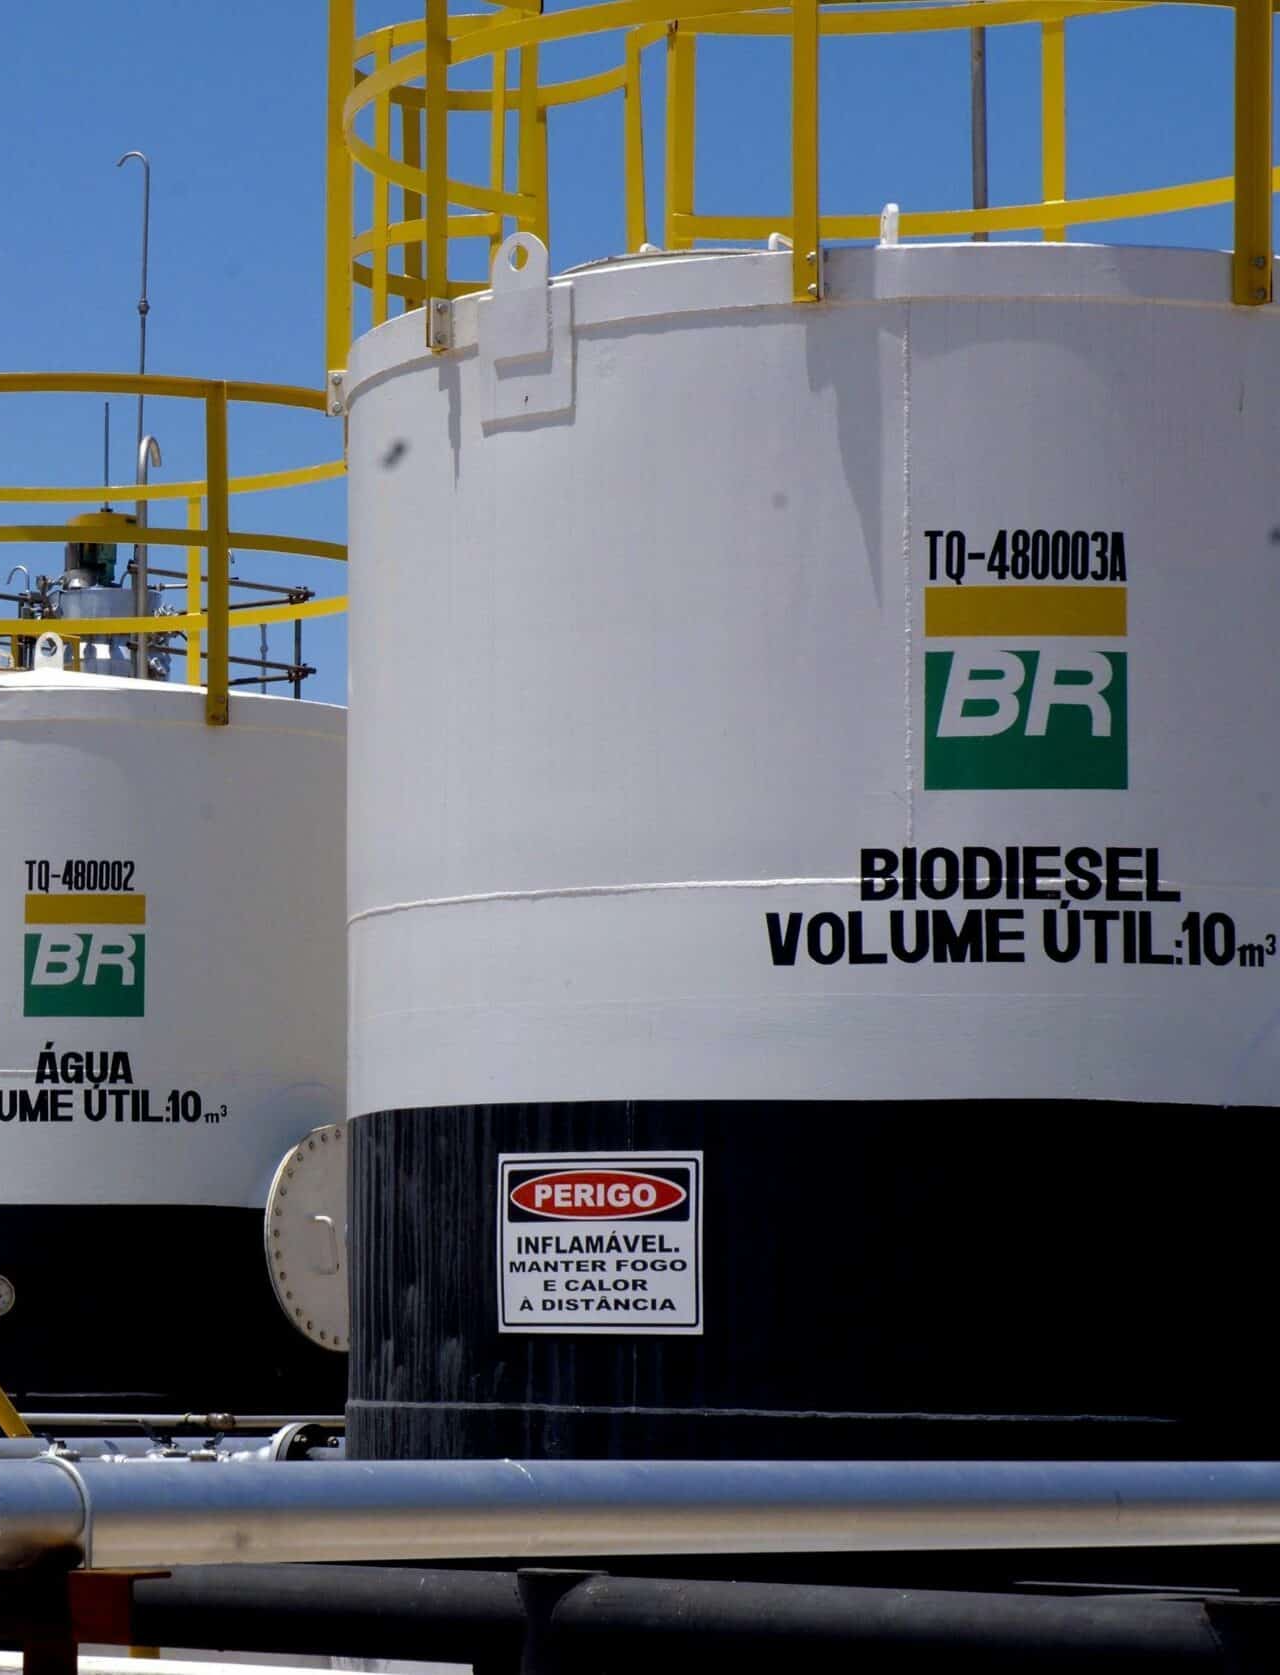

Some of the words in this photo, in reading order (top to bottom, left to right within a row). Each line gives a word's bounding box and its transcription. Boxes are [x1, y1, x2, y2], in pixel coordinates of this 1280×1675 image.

[924, 530, 1127, 585] TQ-480003A
[936, 651, 1113, 738] BR
[25, 860, 135, 893] TQ-480002
[861, 846, 1181, 902] BIODIESEL
[766, 908, 1025, 966] VOLUME
[31, 932, 136, 986] BR
[35, 1041, 133, 1084] ÁGUA
[533, 1183, 657, 1208] PERIGO
[517, 1230, 680, 1254] INFLAMÁVEL.
[509, 1261, 607, 1273] MANTER
[615, 1259, 687, 1272] FOGO
[520, 1296, 534, 1311] À
[541, 1296, 677, 1311] DISTÂNCIA
[543, 1280, 556, 1292] E
[564, 1279, 648, 1292] CALOR
